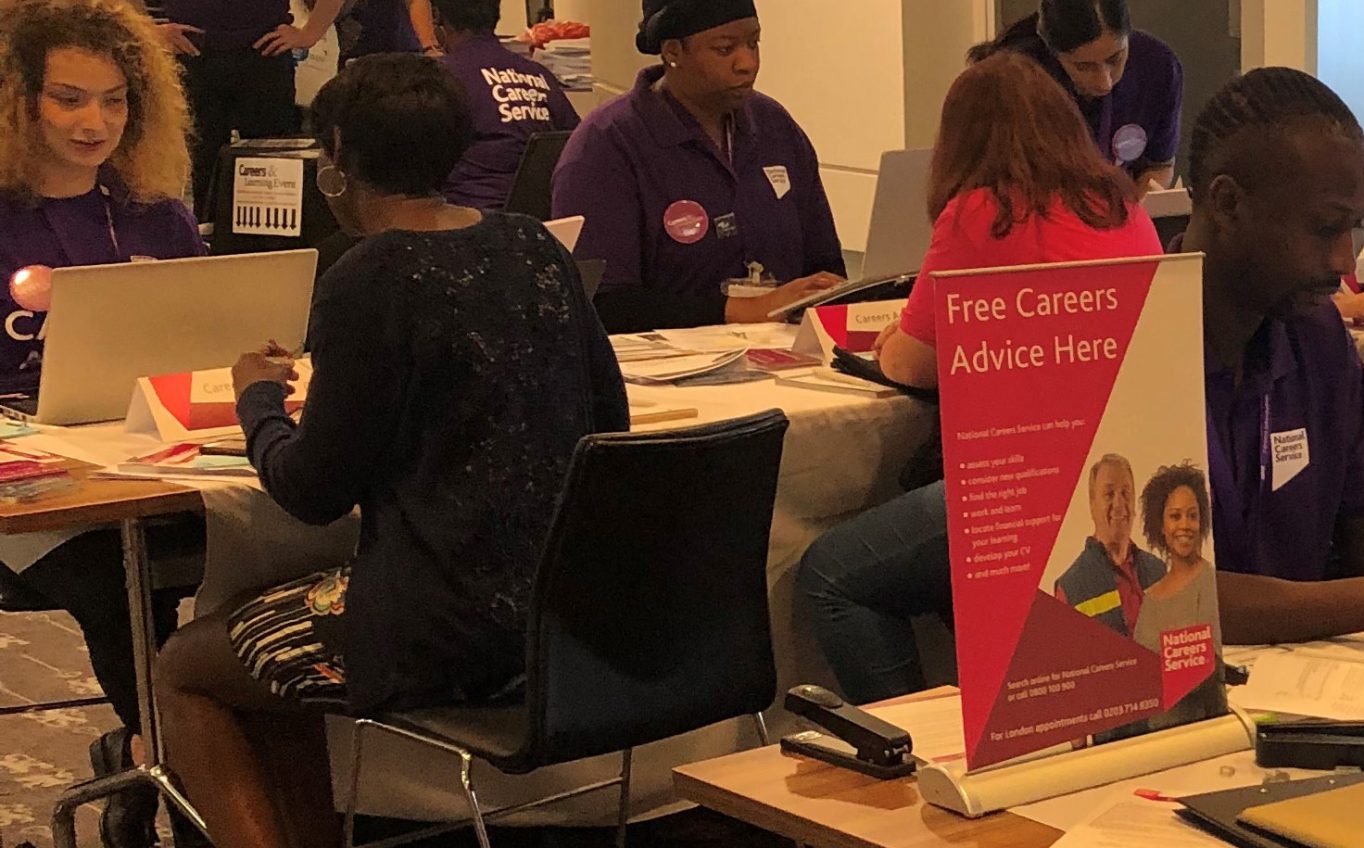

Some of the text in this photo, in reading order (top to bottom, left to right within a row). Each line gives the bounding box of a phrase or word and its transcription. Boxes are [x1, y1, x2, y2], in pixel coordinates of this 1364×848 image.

[946, 287, 1119, 324] Free Careers
[855, 313, 891, 324] Careers
[950, 334, 1118, 376] Advice Here
[203, 383, 232, 394] Care
[957, 429, 990, 440] National
[990, 427, 1017, 437] Careers
[1017, 423, 1041, 434] Service
[1042, 421, 1055, 430] can
[1055, 418, 1070, 429] help
[1274, 431, 1305, 444] National
[1275, 443, 1303, 453] Careers
[1275, 453, 1302, 463] Service
[968, 466, 1060, 486] consider new qualifications
[985, 490, 997, 500] the
[970, 503, 1022, 518] work and learn
[971, 512, 1062, 535] locate financial support for
[972, 533, 1019, 550] your learning
[973, 544, 1032, 563] develop your CV
[974, 569, 990, 579] and
[990, 565, 1010, 577] much
[1163, 625, 1212, 647] National
[1164, 642, 1207, 660] Careers
[1164, 655, 1206, 672] Service
[1007, 657, 1137, 690] Search online for National Careers Service
[1007, 693, 1016, 702] or
[1016, 689, 1028, 701] call
[990, 731, 1004, 742] For
[1005, 725, 1035, 740] London
[1035, 714, 1089, 734] appointments
[1089, 708, 1103, 721] call
